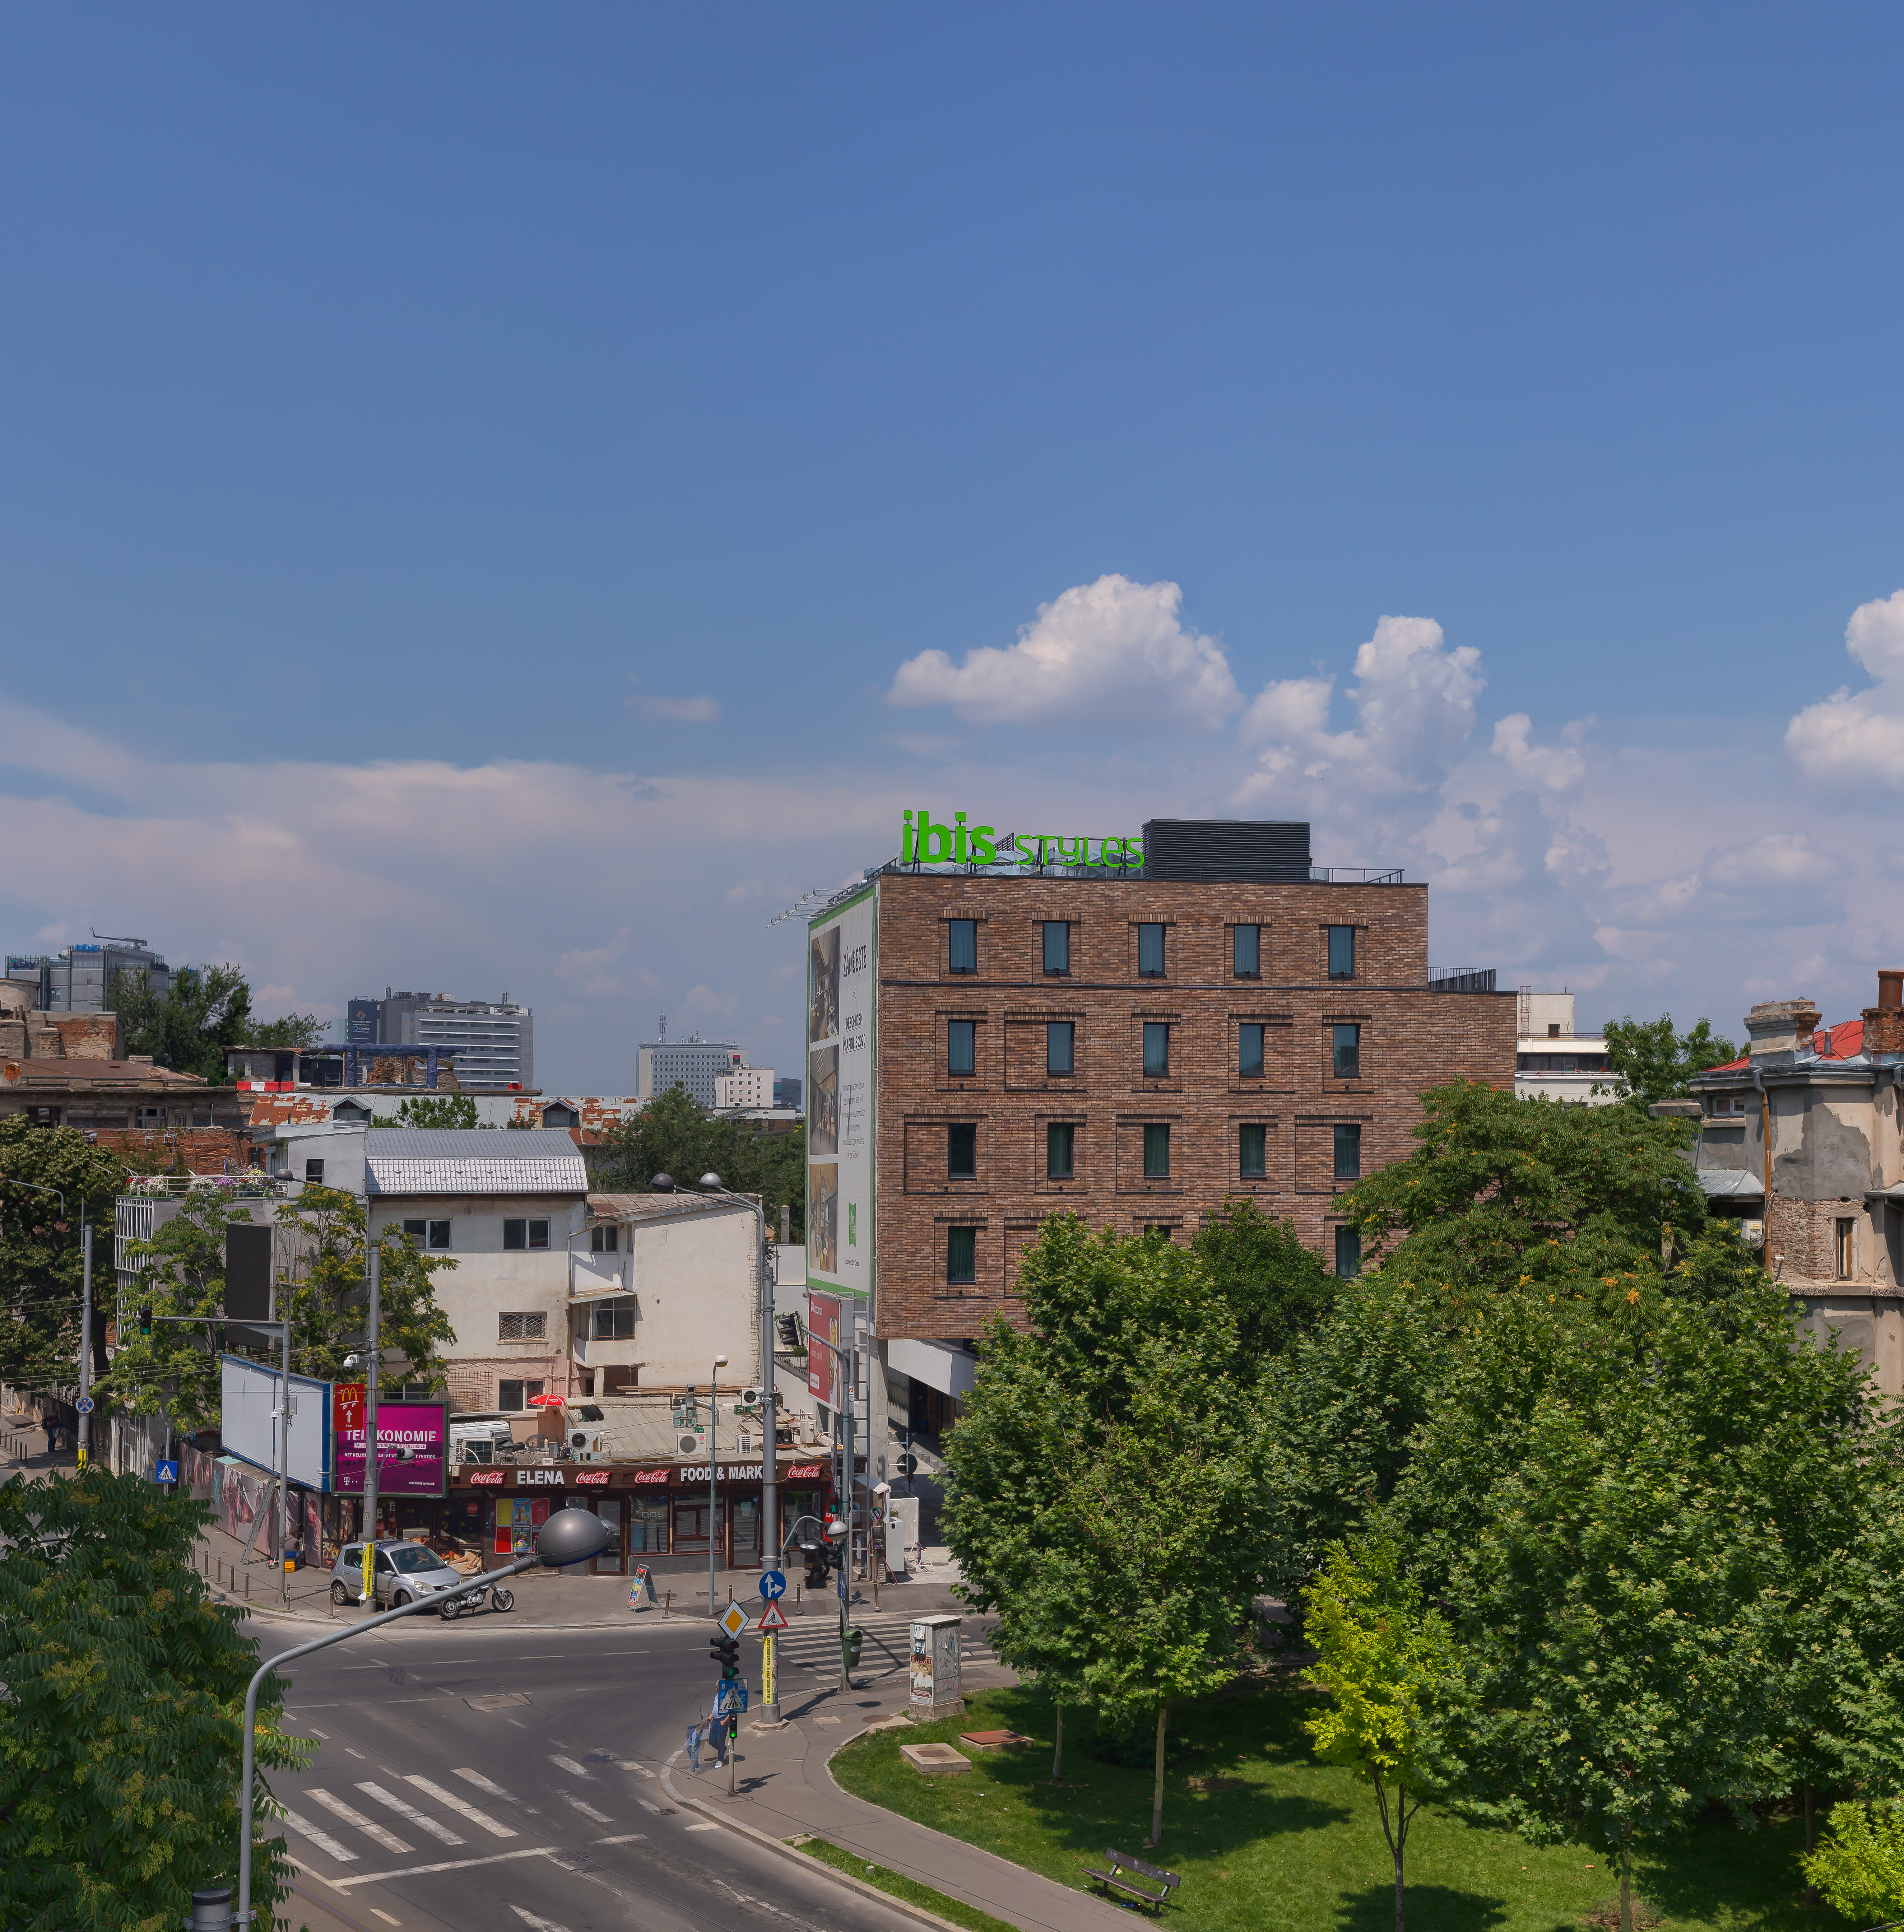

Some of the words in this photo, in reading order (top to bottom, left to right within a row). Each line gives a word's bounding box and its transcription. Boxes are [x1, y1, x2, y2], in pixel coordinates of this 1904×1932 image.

[904, 810, 996, 864] ibis
[846, 1012, 863, 1030] DESCHIDEM
[846, 1036, 858, 1051] APRILIE
[345, 1430, 436, 1442] TELKONOMIE
[470, 1471, 505, 1484] Coca-Cola
[517, 1470, 565, 1484] ELENA
[576, 1471, 610, 1485] Coca-Cola
[635, 1470, 670, 1484] Coca-Cola
[681, 1467, 711, 1481] FOOD
[716, 1467, 725, 1480] &
[729, 1465, 777, 1480] MARK
[788, 1466, 821, 1479] Coca-Cola
[911, 1656, 932, 1665] FUEGO
